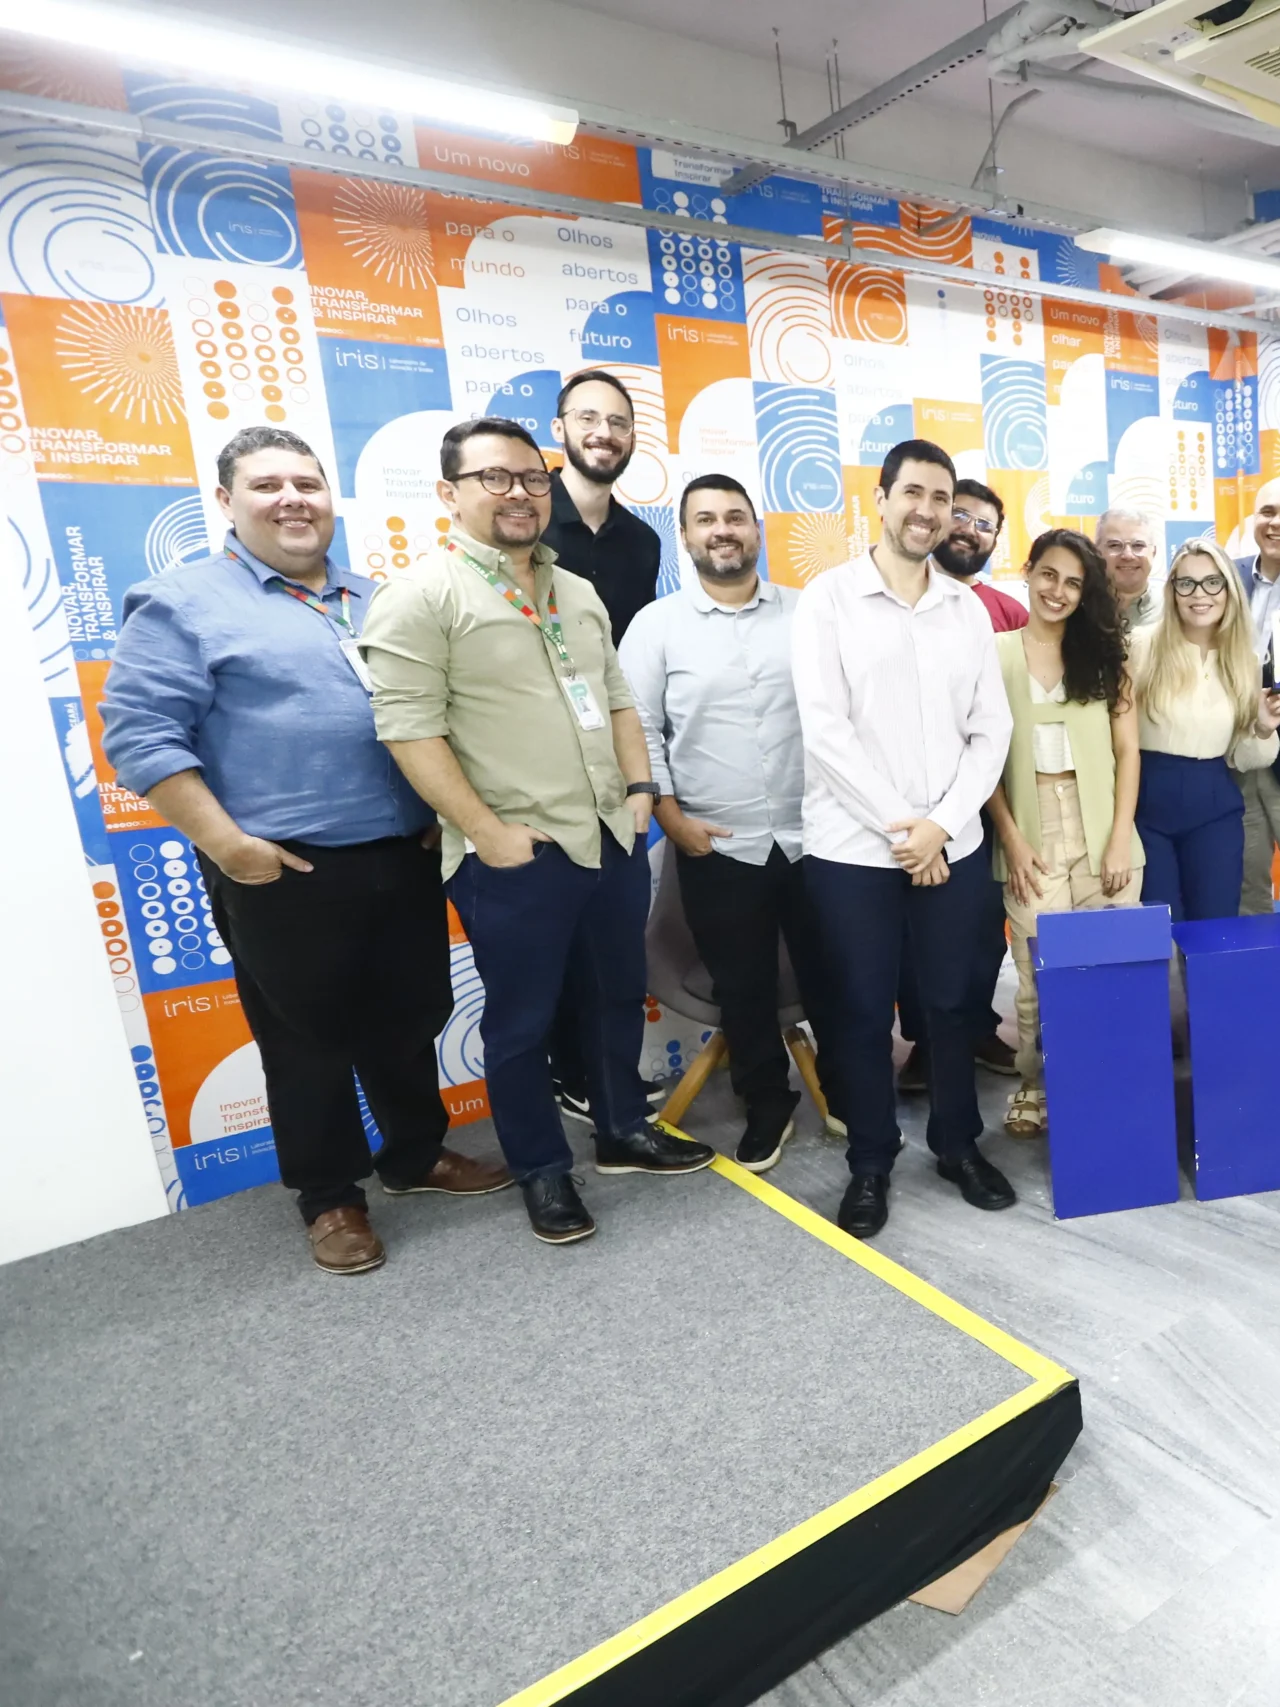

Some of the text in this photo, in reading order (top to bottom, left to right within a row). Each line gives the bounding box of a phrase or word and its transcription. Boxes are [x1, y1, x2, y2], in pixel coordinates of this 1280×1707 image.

[434, 145, 530, 177] Um novo
[445, 220, 515, 242] para o
[557, 226, 613, 249] Olhos
[450, 256, 526, 278] mundo
[561, 261, 638, 285] abertos
[309, 296, 424, 319] TRANSFORMAR
[565, 296, 627, 316] para o
[312, 308, 398, 325] & INSPIRAR
[456, 306, 517, 328] Olhos
[1050, 307, 1100, 326] Um novo
[569, 328, 632, 349] futuro
[1051, 333, 1082, 347] olhar
[460, 343, 545, 364] abertos
[465, 379, 533, 397] para o
[1189, 380, 1198, 389] o
[884, 415, 895, 426] o
[30, 438, 172, 456] TRANSFORMAR
[33, 451, 139, 466] & INSPIRAR
[65, 525, 101, 642] TRANSFORMAR
[88, 556, 118, 641] & INSPIRAR
[61, 582, 87, 642] INOVAR,
[103, 803, 116, 815] &
[219, 1096, 264, 1113] Inovar
[450, 1096, 484, 1116] Um
